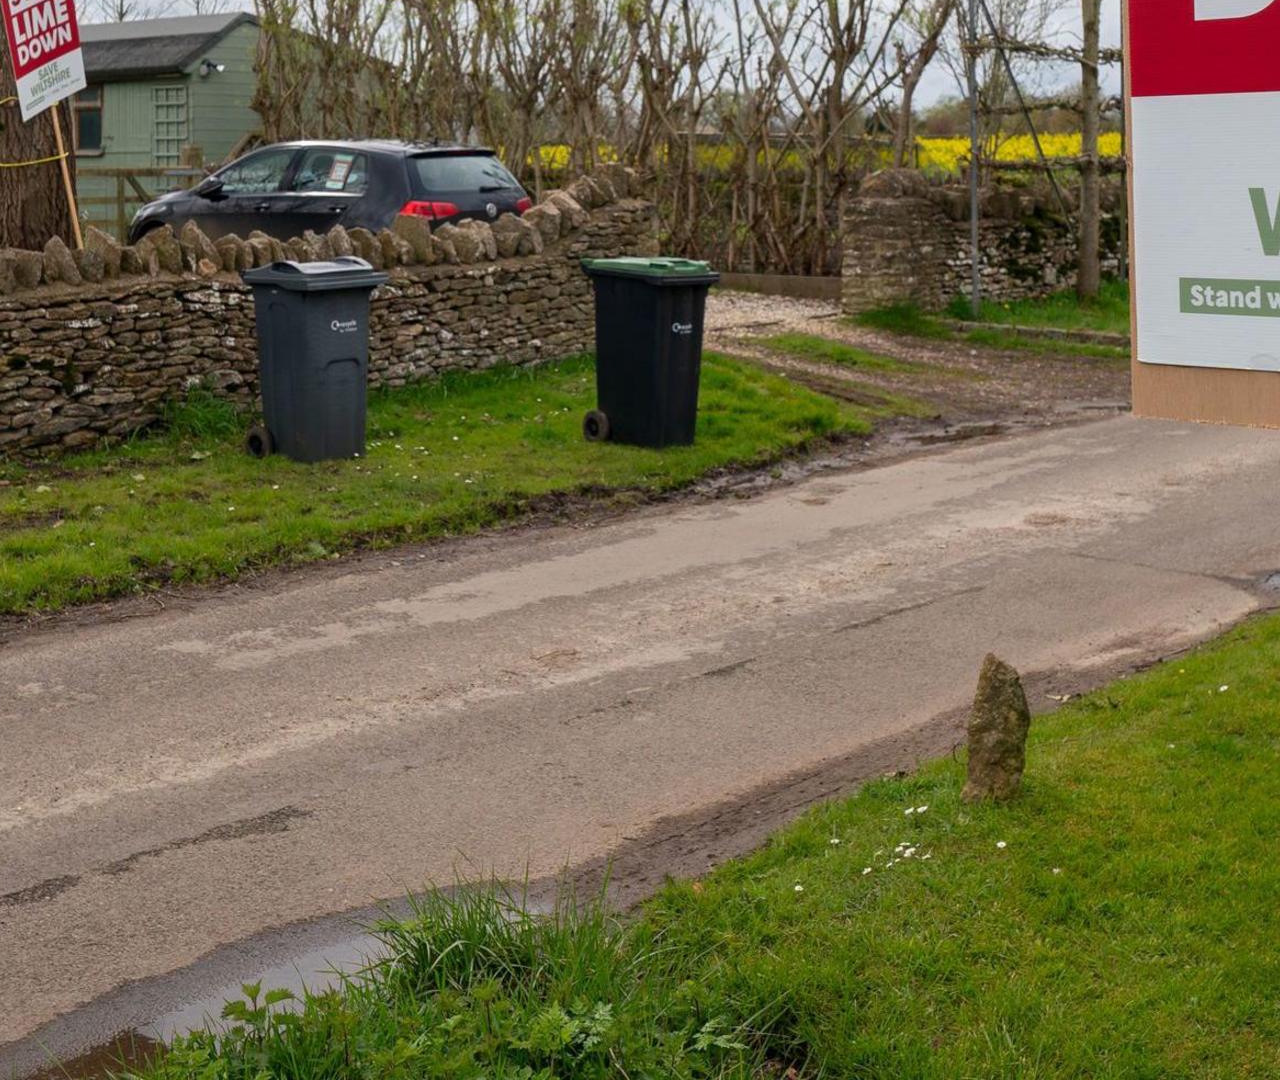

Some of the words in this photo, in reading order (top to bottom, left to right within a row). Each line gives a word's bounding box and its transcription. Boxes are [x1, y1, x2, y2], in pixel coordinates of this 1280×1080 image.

[17, 23, 72, 67] DOWN
[31, 67, 71, 97] WILTSHIRE
[38, 61, 59, 81] SAVE
[1190, 284, 1261, 309] Stand
